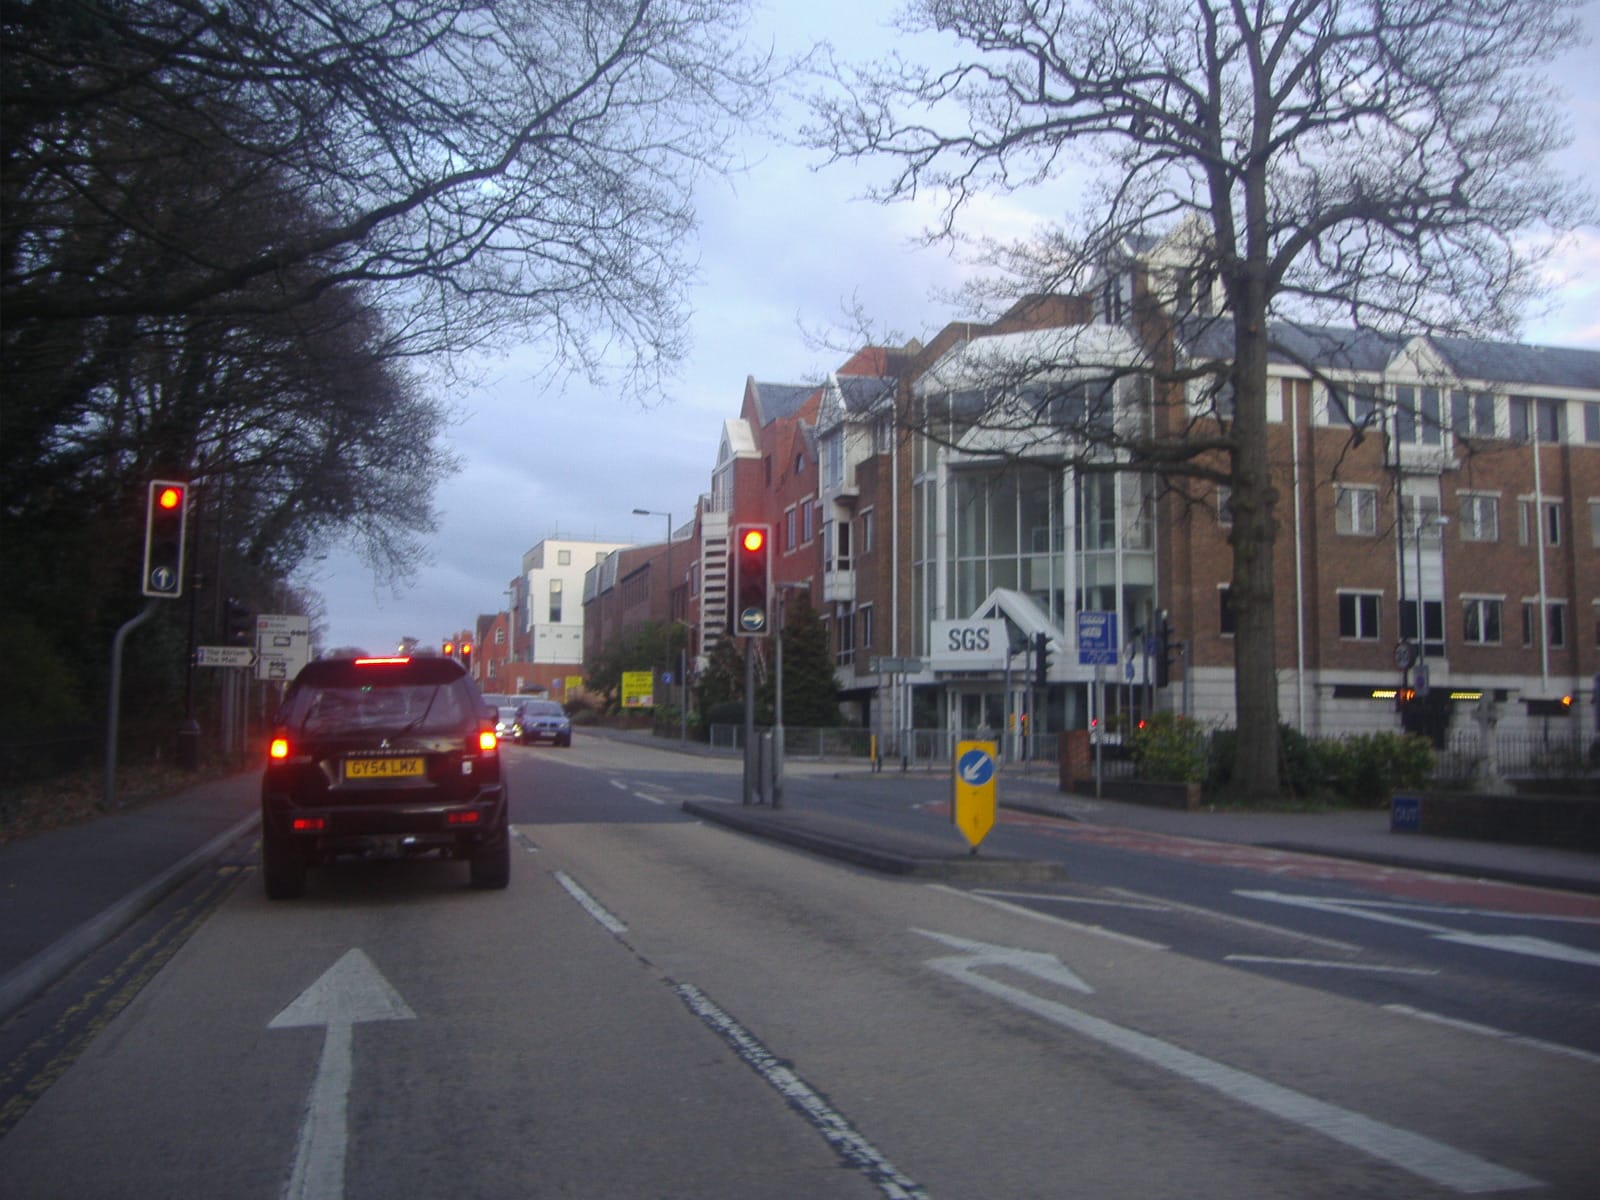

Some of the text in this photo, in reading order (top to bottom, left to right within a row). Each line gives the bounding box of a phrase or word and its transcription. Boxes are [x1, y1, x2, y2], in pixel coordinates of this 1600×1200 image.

[948, 628, 989, 651] SGS
[352, 758, 417, 775] GY54 LMX
